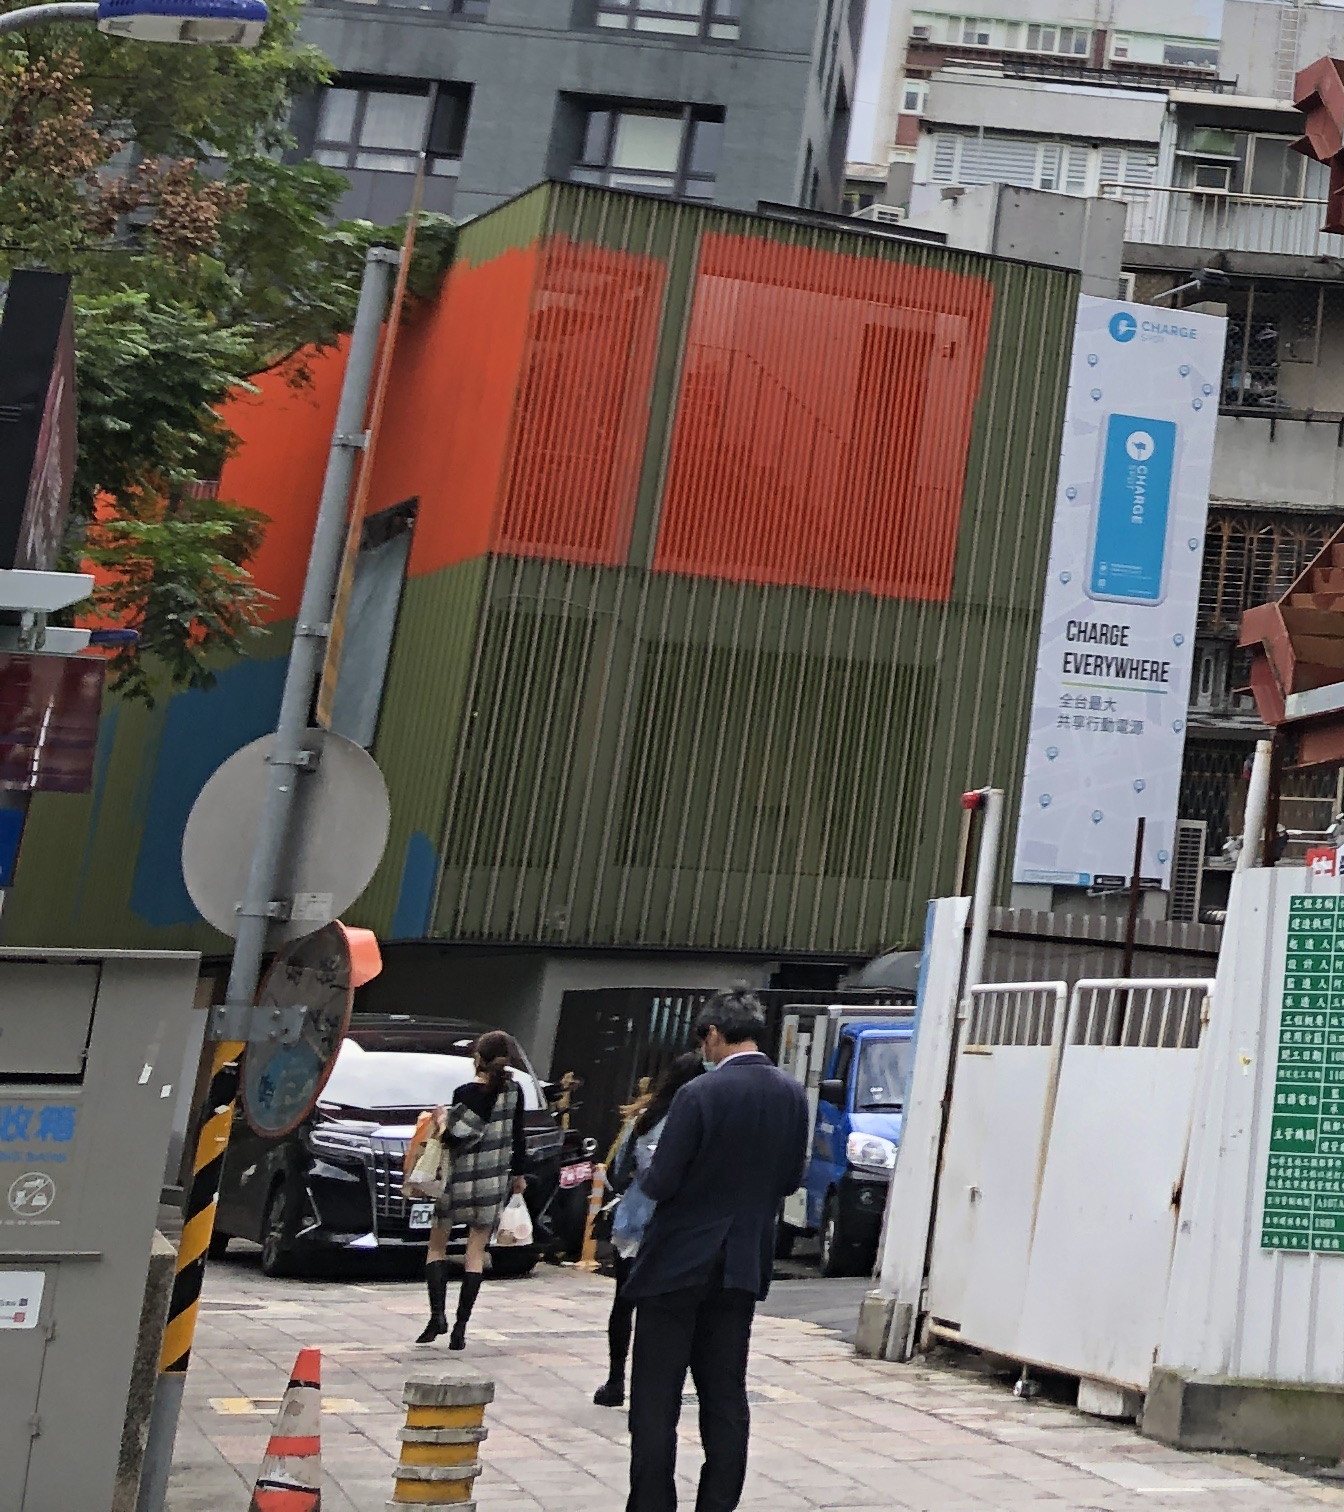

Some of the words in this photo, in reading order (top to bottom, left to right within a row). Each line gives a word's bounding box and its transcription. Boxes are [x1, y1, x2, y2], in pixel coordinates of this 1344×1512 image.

[1141, 321, 1198, 340] CHARGE
[1131, 465, 1148, 524] CHARGE
[1066, 620, 1130, 647] CHARGE
[1062, 652, 1171, 683] EVERYWHERE
[1059, 693, 1117, 712] 全台最大
